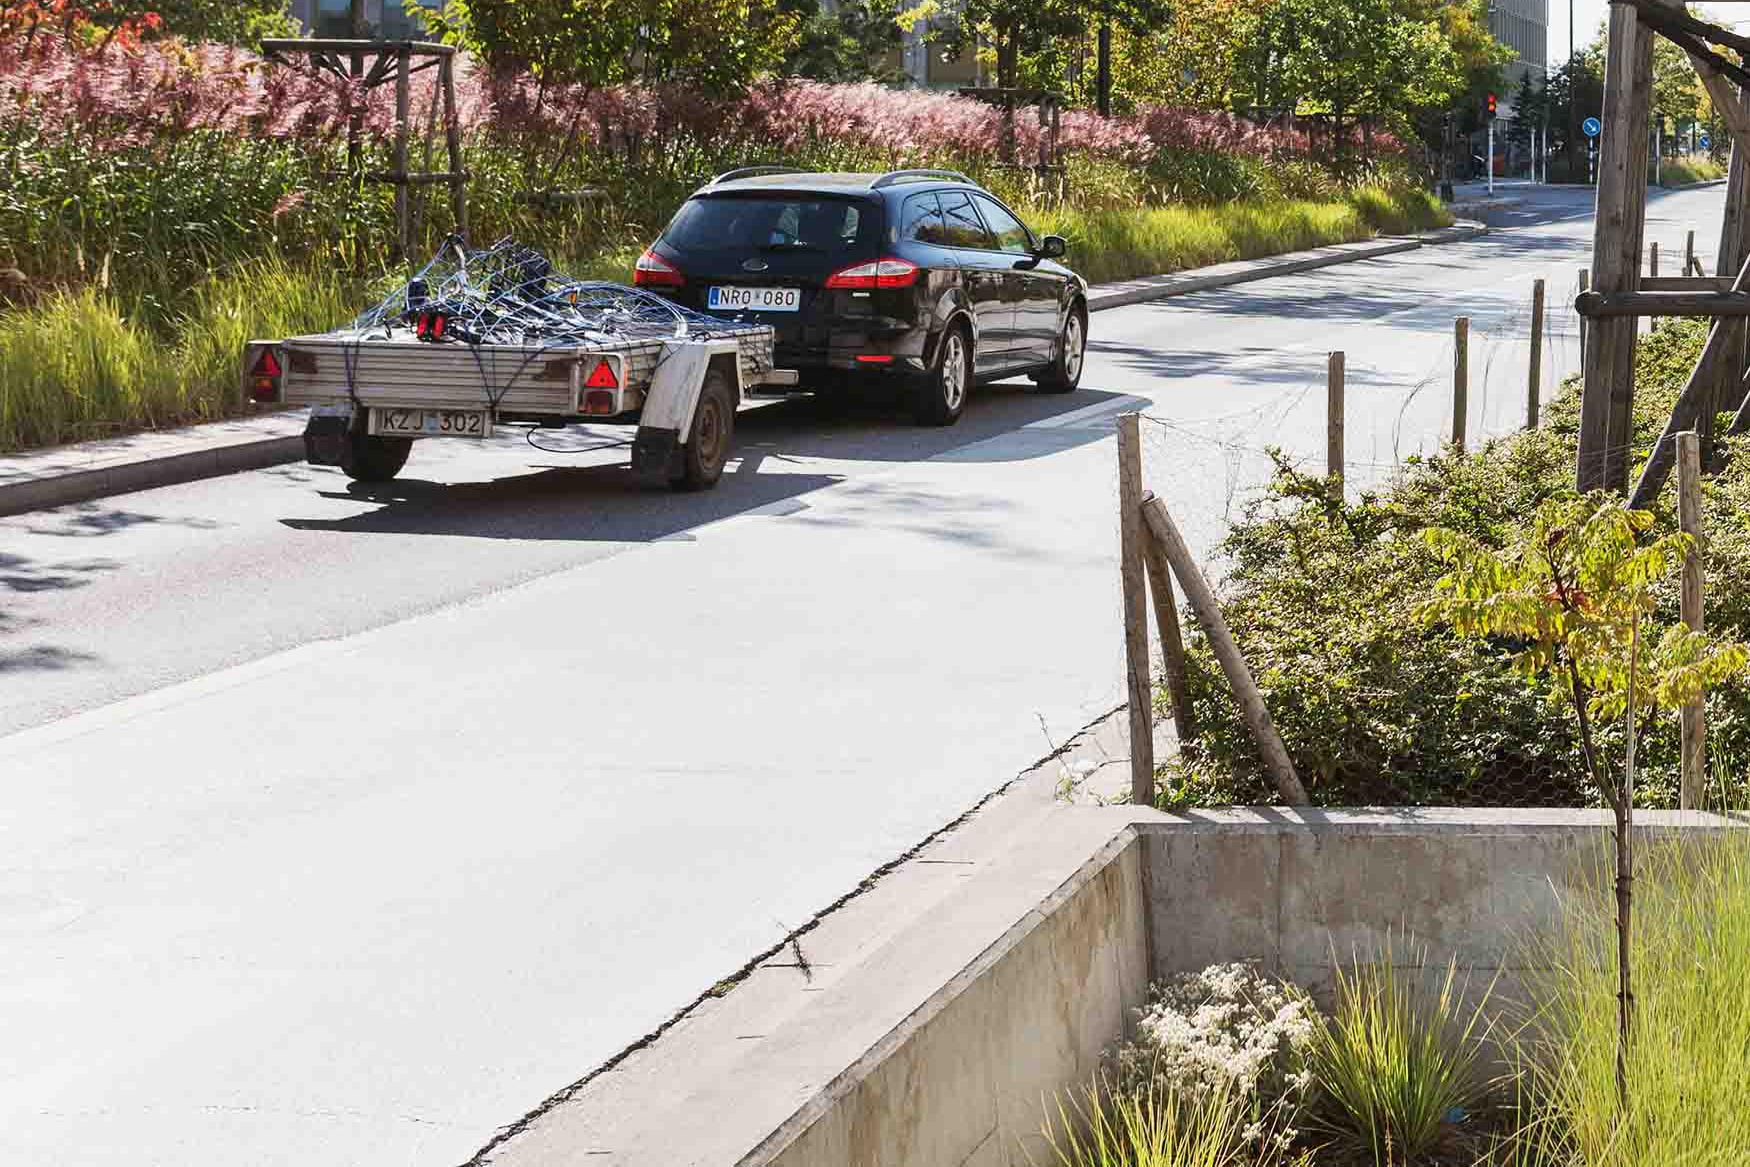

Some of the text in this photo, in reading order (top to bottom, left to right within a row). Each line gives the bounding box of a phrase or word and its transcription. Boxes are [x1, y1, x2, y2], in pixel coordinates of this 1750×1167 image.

[720, 289, 795, 306] NRO 080
[383, 413, 481, 433] KZJ 302
